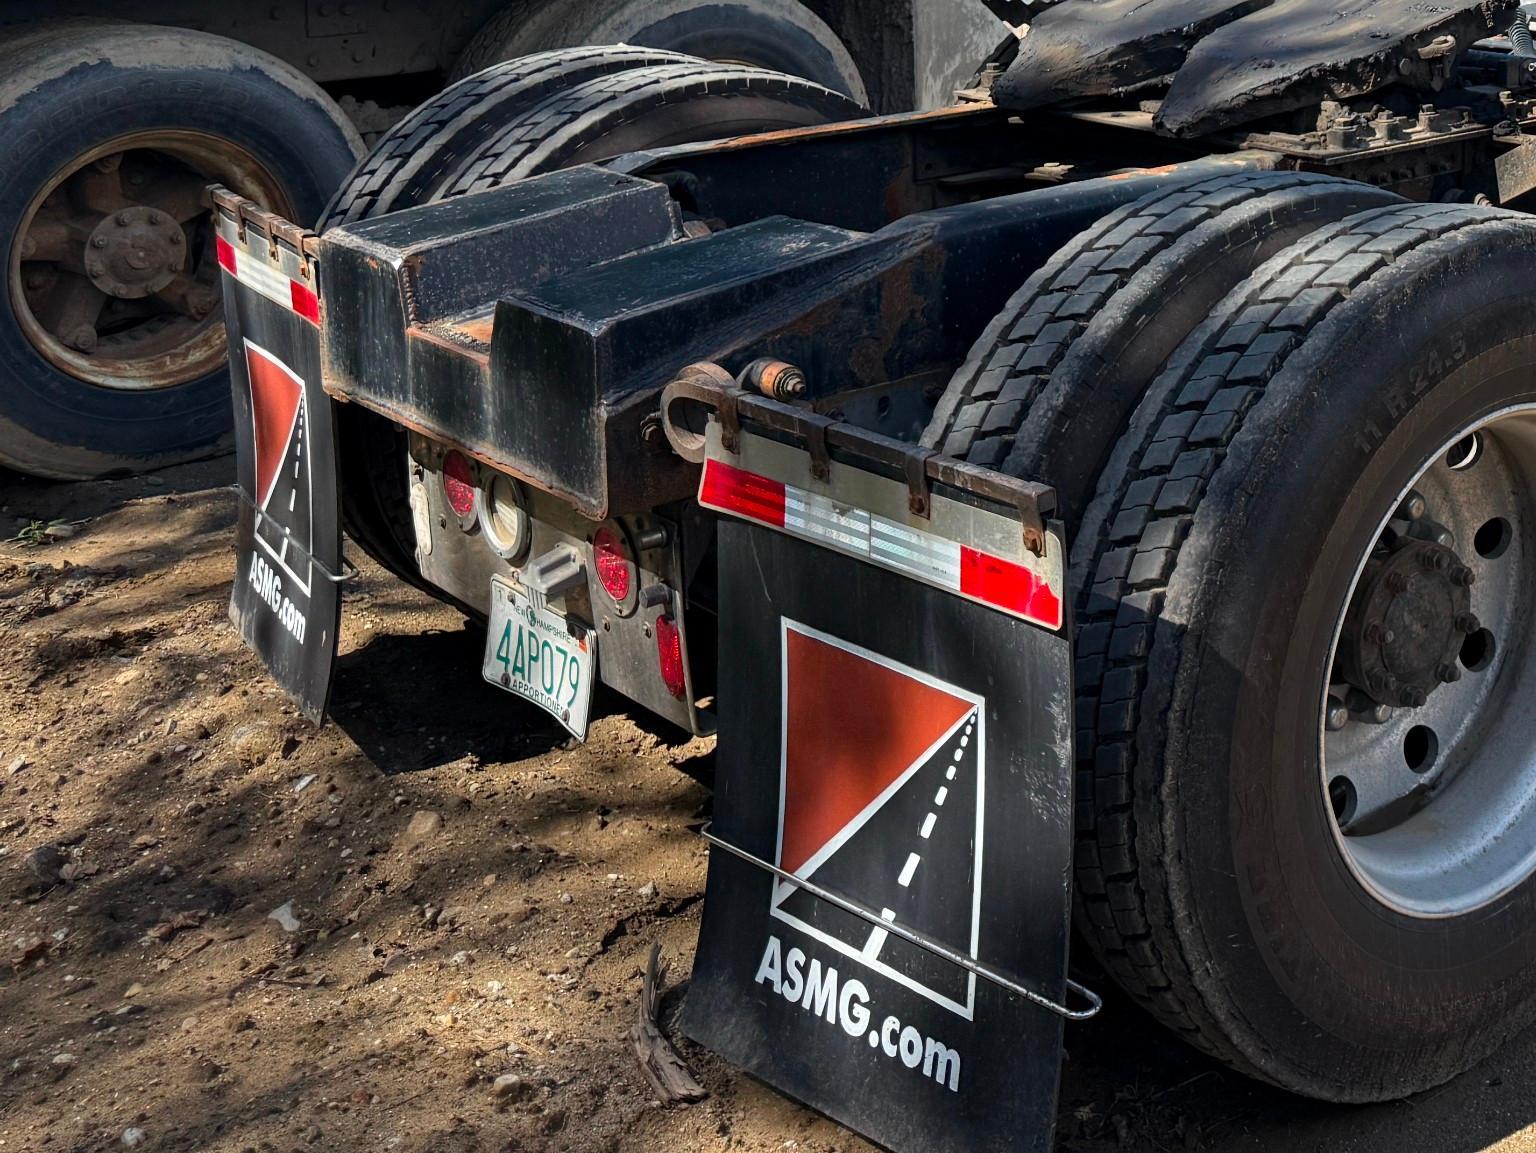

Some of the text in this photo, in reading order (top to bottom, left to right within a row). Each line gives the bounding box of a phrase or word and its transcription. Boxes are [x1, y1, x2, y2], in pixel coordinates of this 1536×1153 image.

[248, 550, 307, 646] ASMG.com
[536, 619, 572, 644] HAMPSHIRE
[754, 935, 962, 1094] ASMG.com
